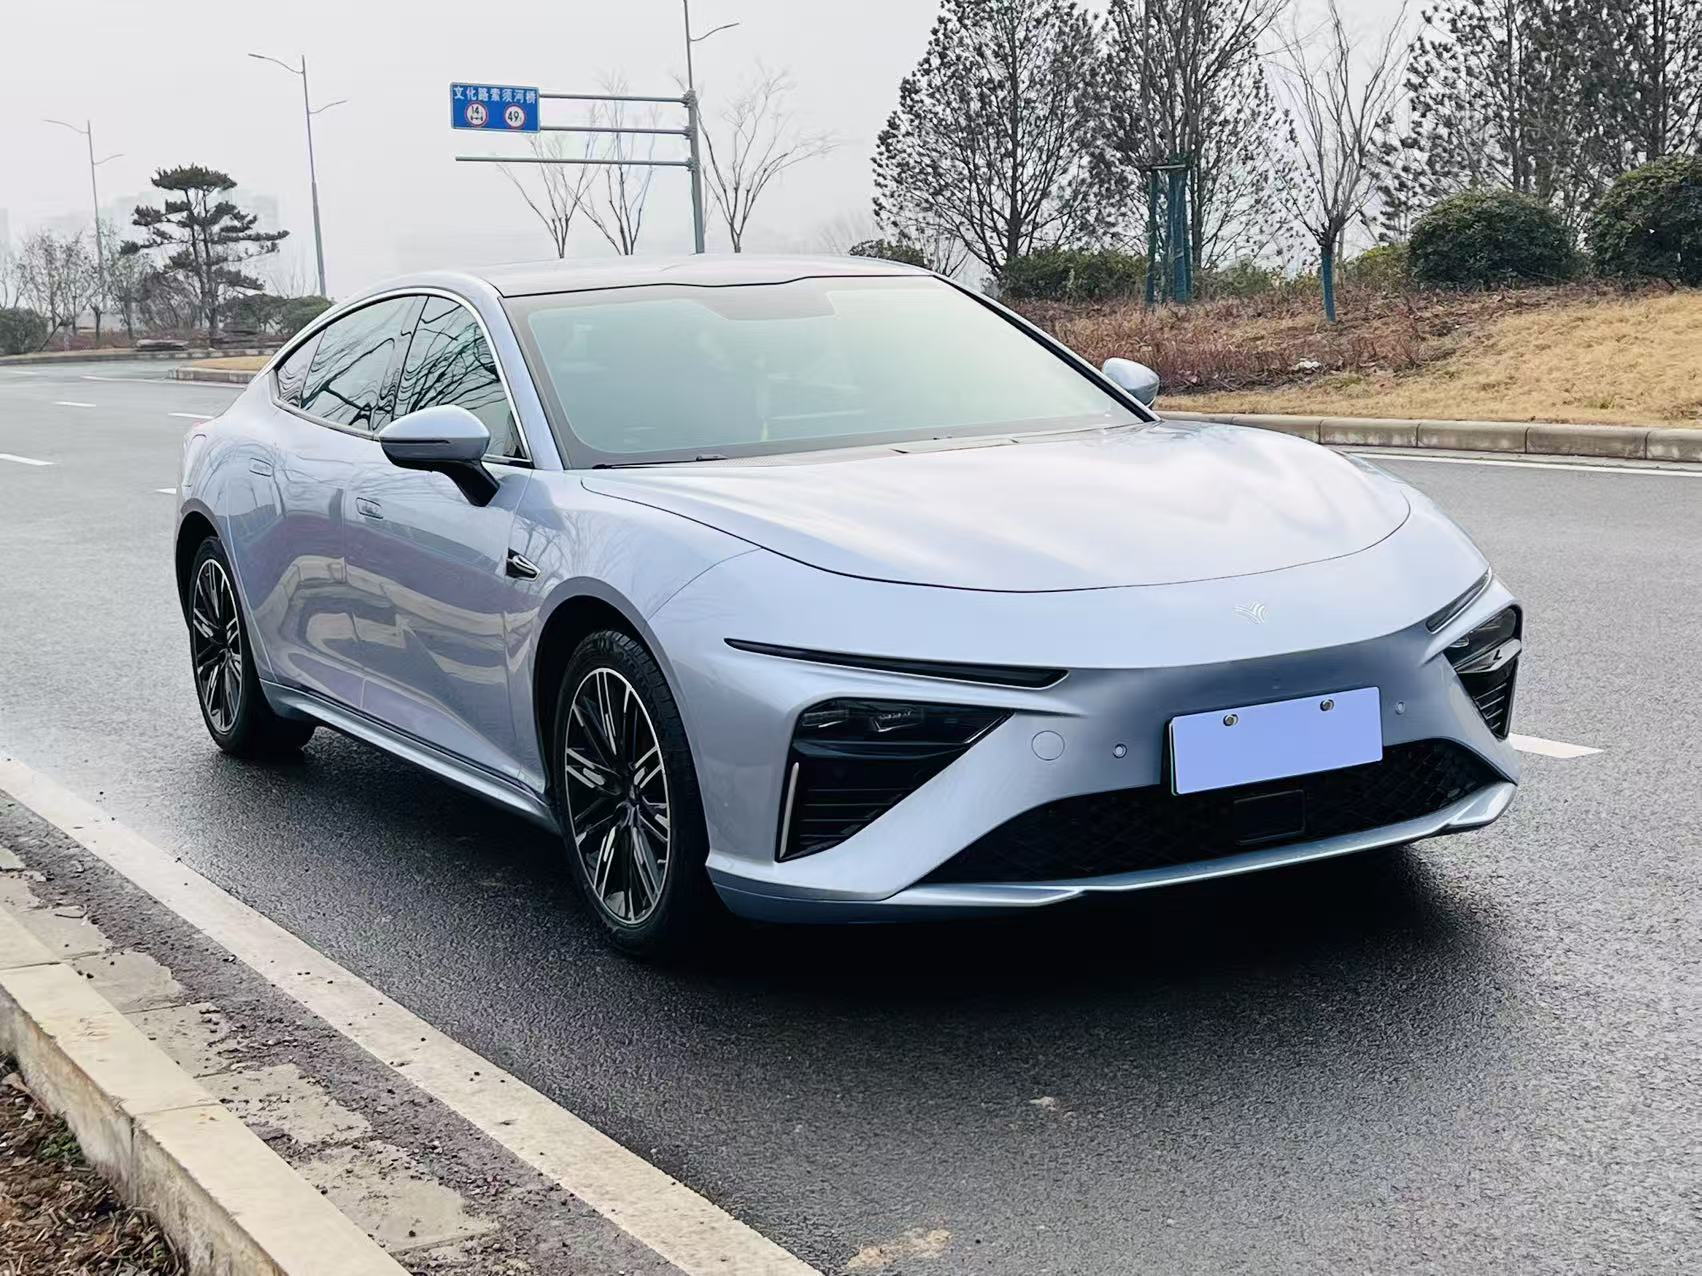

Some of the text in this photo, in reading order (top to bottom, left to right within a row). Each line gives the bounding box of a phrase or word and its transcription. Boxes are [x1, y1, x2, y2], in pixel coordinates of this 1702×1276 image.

[453, 86, 536, 104] 文化路索须河桥
